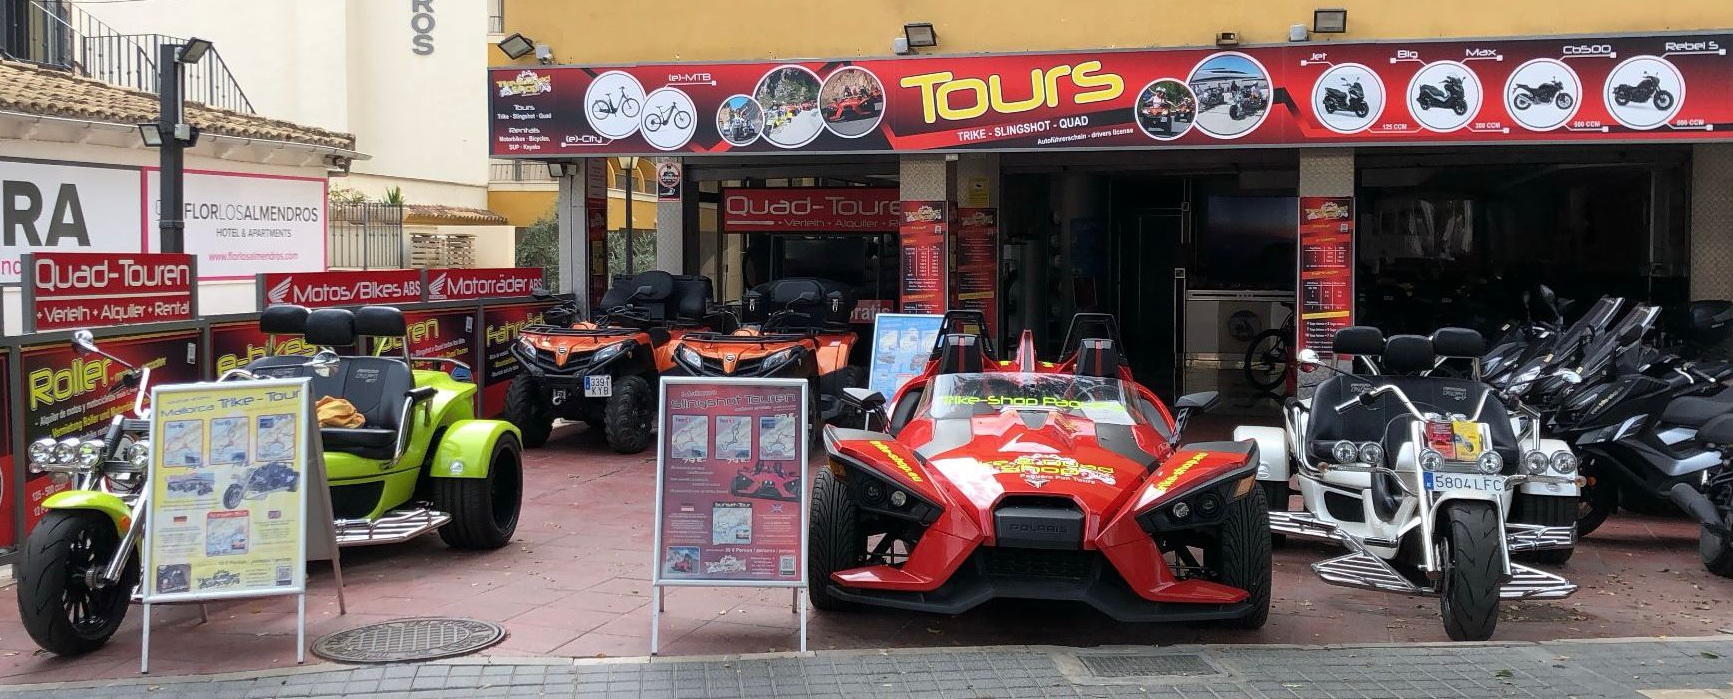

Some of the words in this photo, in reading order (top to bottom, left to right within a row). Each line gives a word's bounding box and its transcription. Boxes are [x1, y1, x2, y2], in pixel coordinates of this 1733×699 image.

[1465, 48, 1497, 57] Max
[1563, 45, 1612, 54] Cb500
[1666, 42, 1706, 51] Rebel
[1708, 41, 1719, 50] S
[1309, 52, 1327, 61] Jet
[1397, 50, 1418, 60] Big
[668, 73, 711, 83] (e)-MTB
[900, 60, 1124, 124] Tours
[957, 129, 986, 142] TRIKE
[994, 120, 1051, 137] SLINGSHOT
[1059, 116, 1089, 129] QUAD
[1037, 133, 1087, 145] Autoführerschein
[1091, 131, 1112, 139] drivers
[1112, 128, 1134, 136] license
[566, 135, 603, 144] (e)-City
[3, 180, 91, 246] RA
[185, 203, 318, 222] FLORLOSALMENDROS
[727, 196, 900, 217] Quad-Toure
[784, 219, 824, 227] Verleih
[834, 219, 878, 228] Alquiler
[216, 228, 240, 237] HOTEL
[242, 229, 246, 237] &
[248, 228, 292, 238] APARTMENTS
[208, 252, 299, 261] www.florlosalmendros.com
[35, 258, 190, 292] Quad-Touren
[293, 282, 401, 303] Motos/Bikes
[403, 280, 421, 296] ABS
[447, 274, 527, 295] Motorräder
[529, 278, 542, 291] ABS
[44, 306, 90, 323] Verleih
[100, 304, 146, 321] Alquiler
[155, 301, 189, 316] Rental
[29, 358, 113, 411] Roller
[161, 404, 215, 417] Mallorca
[218, 397, 255, 408] Trike
[671, 395, 741, 411] Slingshot
[744, 393, 796, 405] Touren
[1073, 476, 1096, 484] Tours
[1009, 523, 1069, 534] POLARIS
